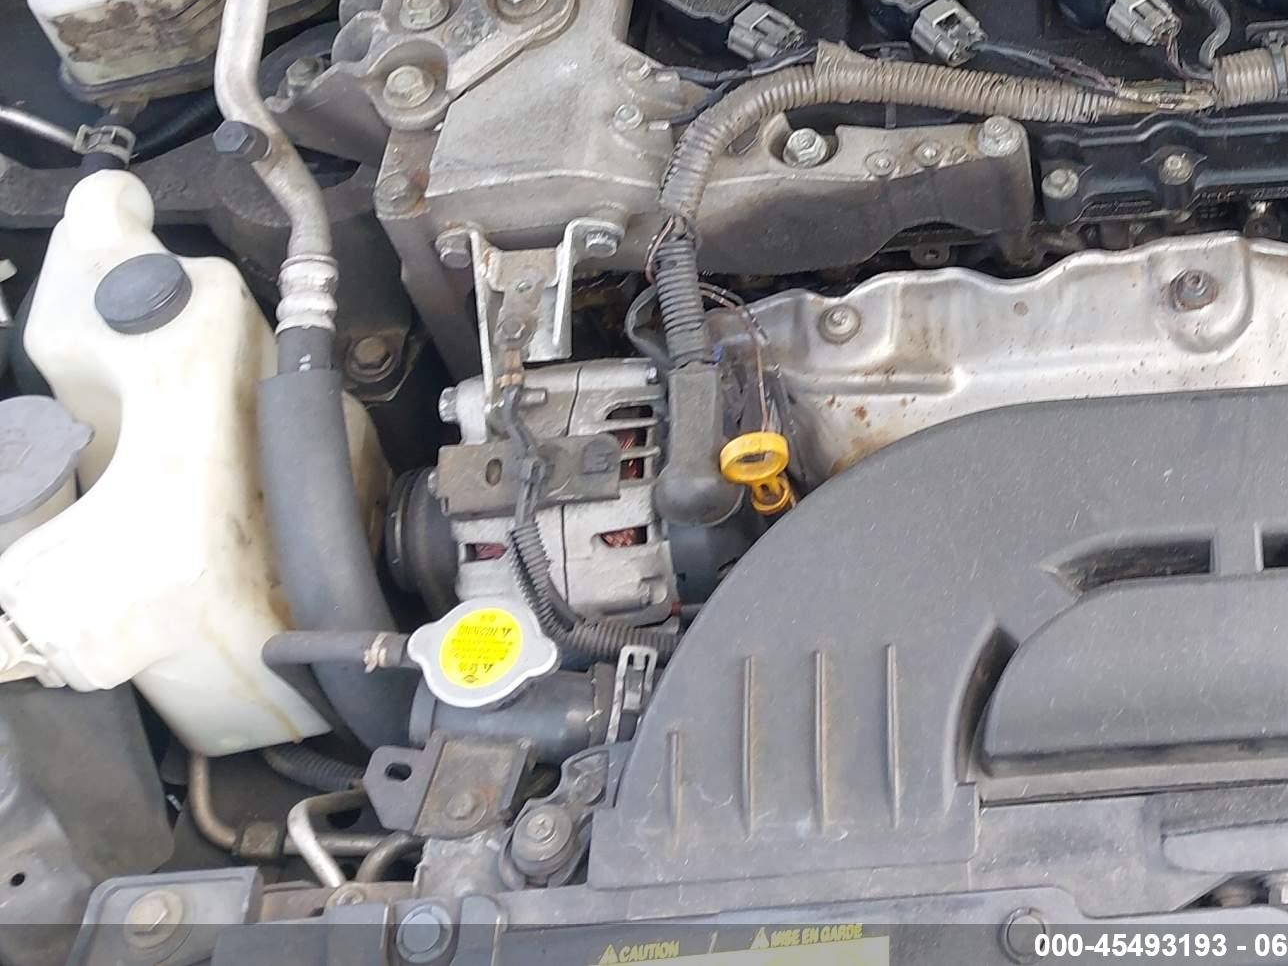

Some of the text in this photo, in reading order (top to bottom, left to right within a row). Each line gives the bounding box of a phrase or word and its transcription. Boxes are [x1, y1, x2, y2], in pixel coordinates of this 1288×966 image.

[802, 926, 820, 944] EN
[820, 923, 864, 943] GARDE
[618, 940, 680, 962] CAUTION
